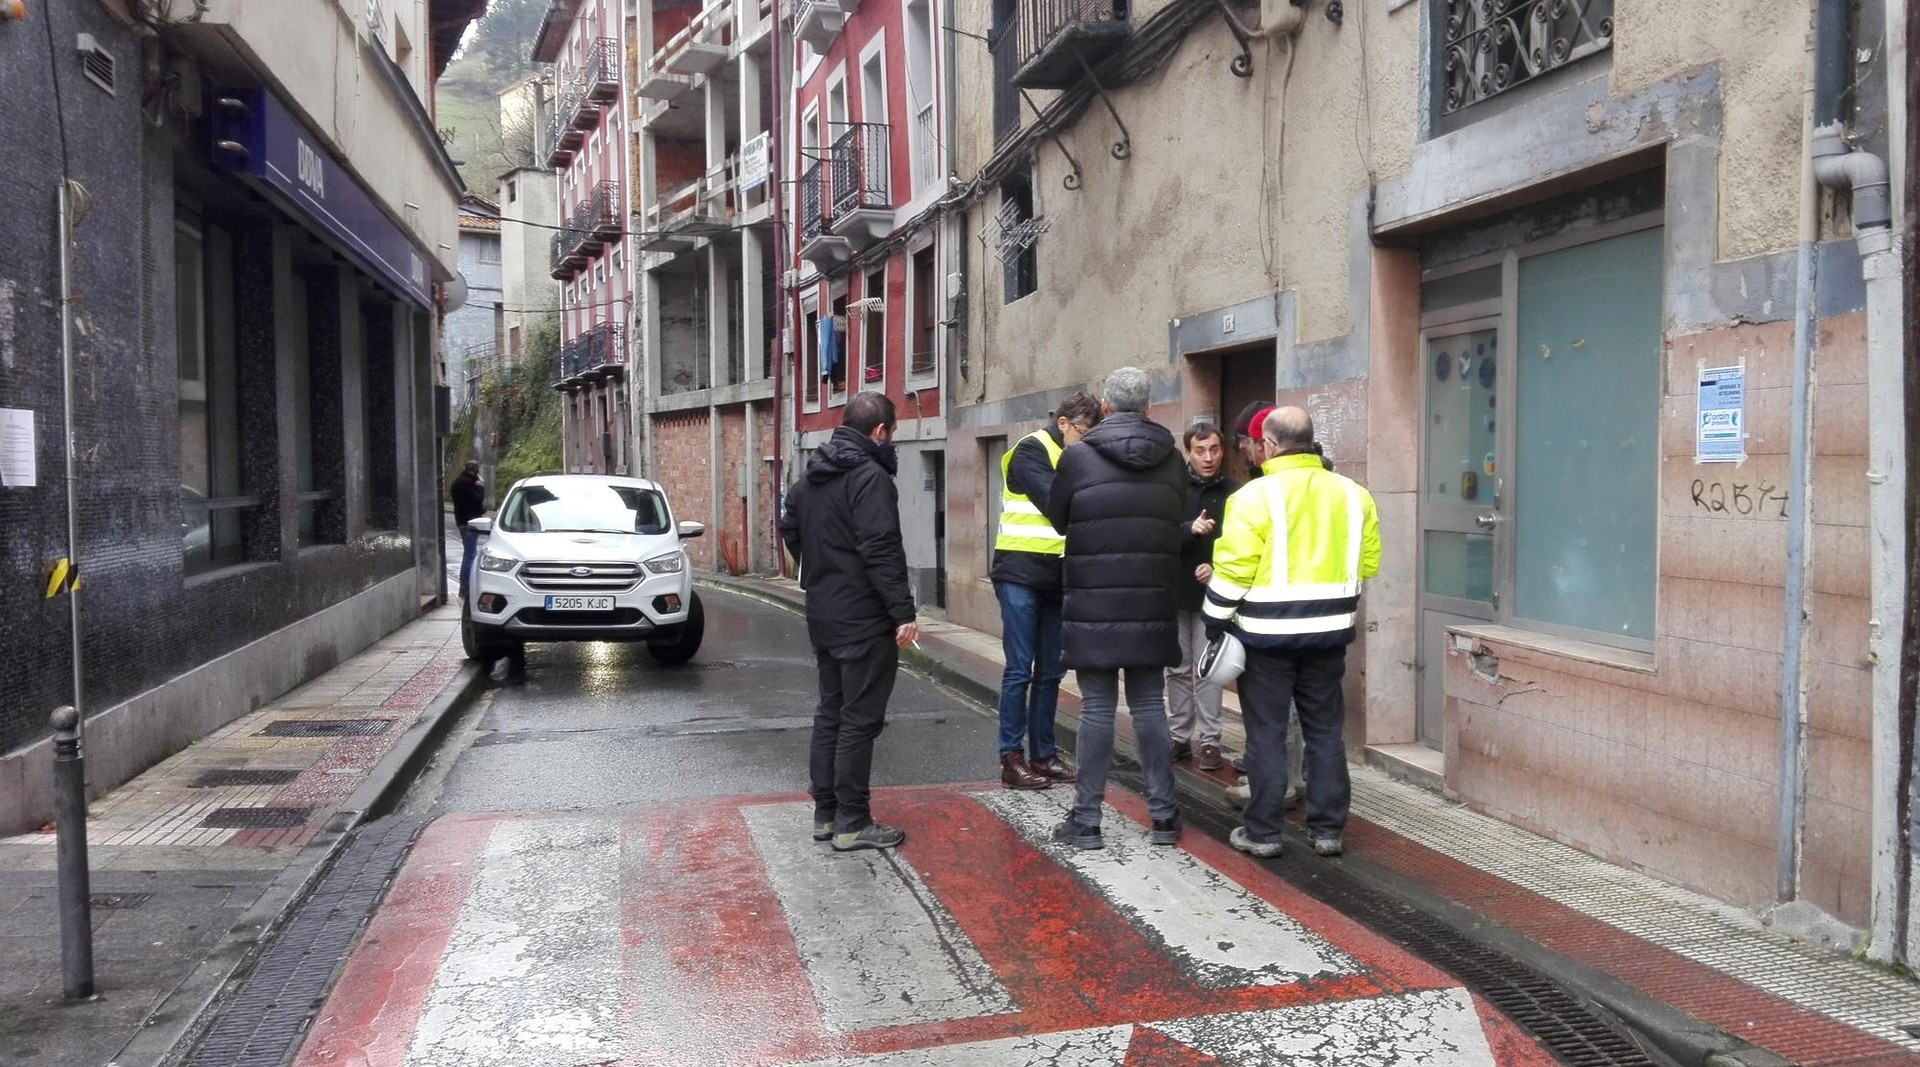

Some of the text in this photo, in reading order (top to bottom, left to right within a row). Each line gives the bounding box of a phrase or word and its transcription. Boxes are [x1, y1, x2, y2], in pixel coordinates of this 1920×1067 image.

[298, 138, 325, 200] BBVA
[555, 598, 608, 609] 5205 KJC
